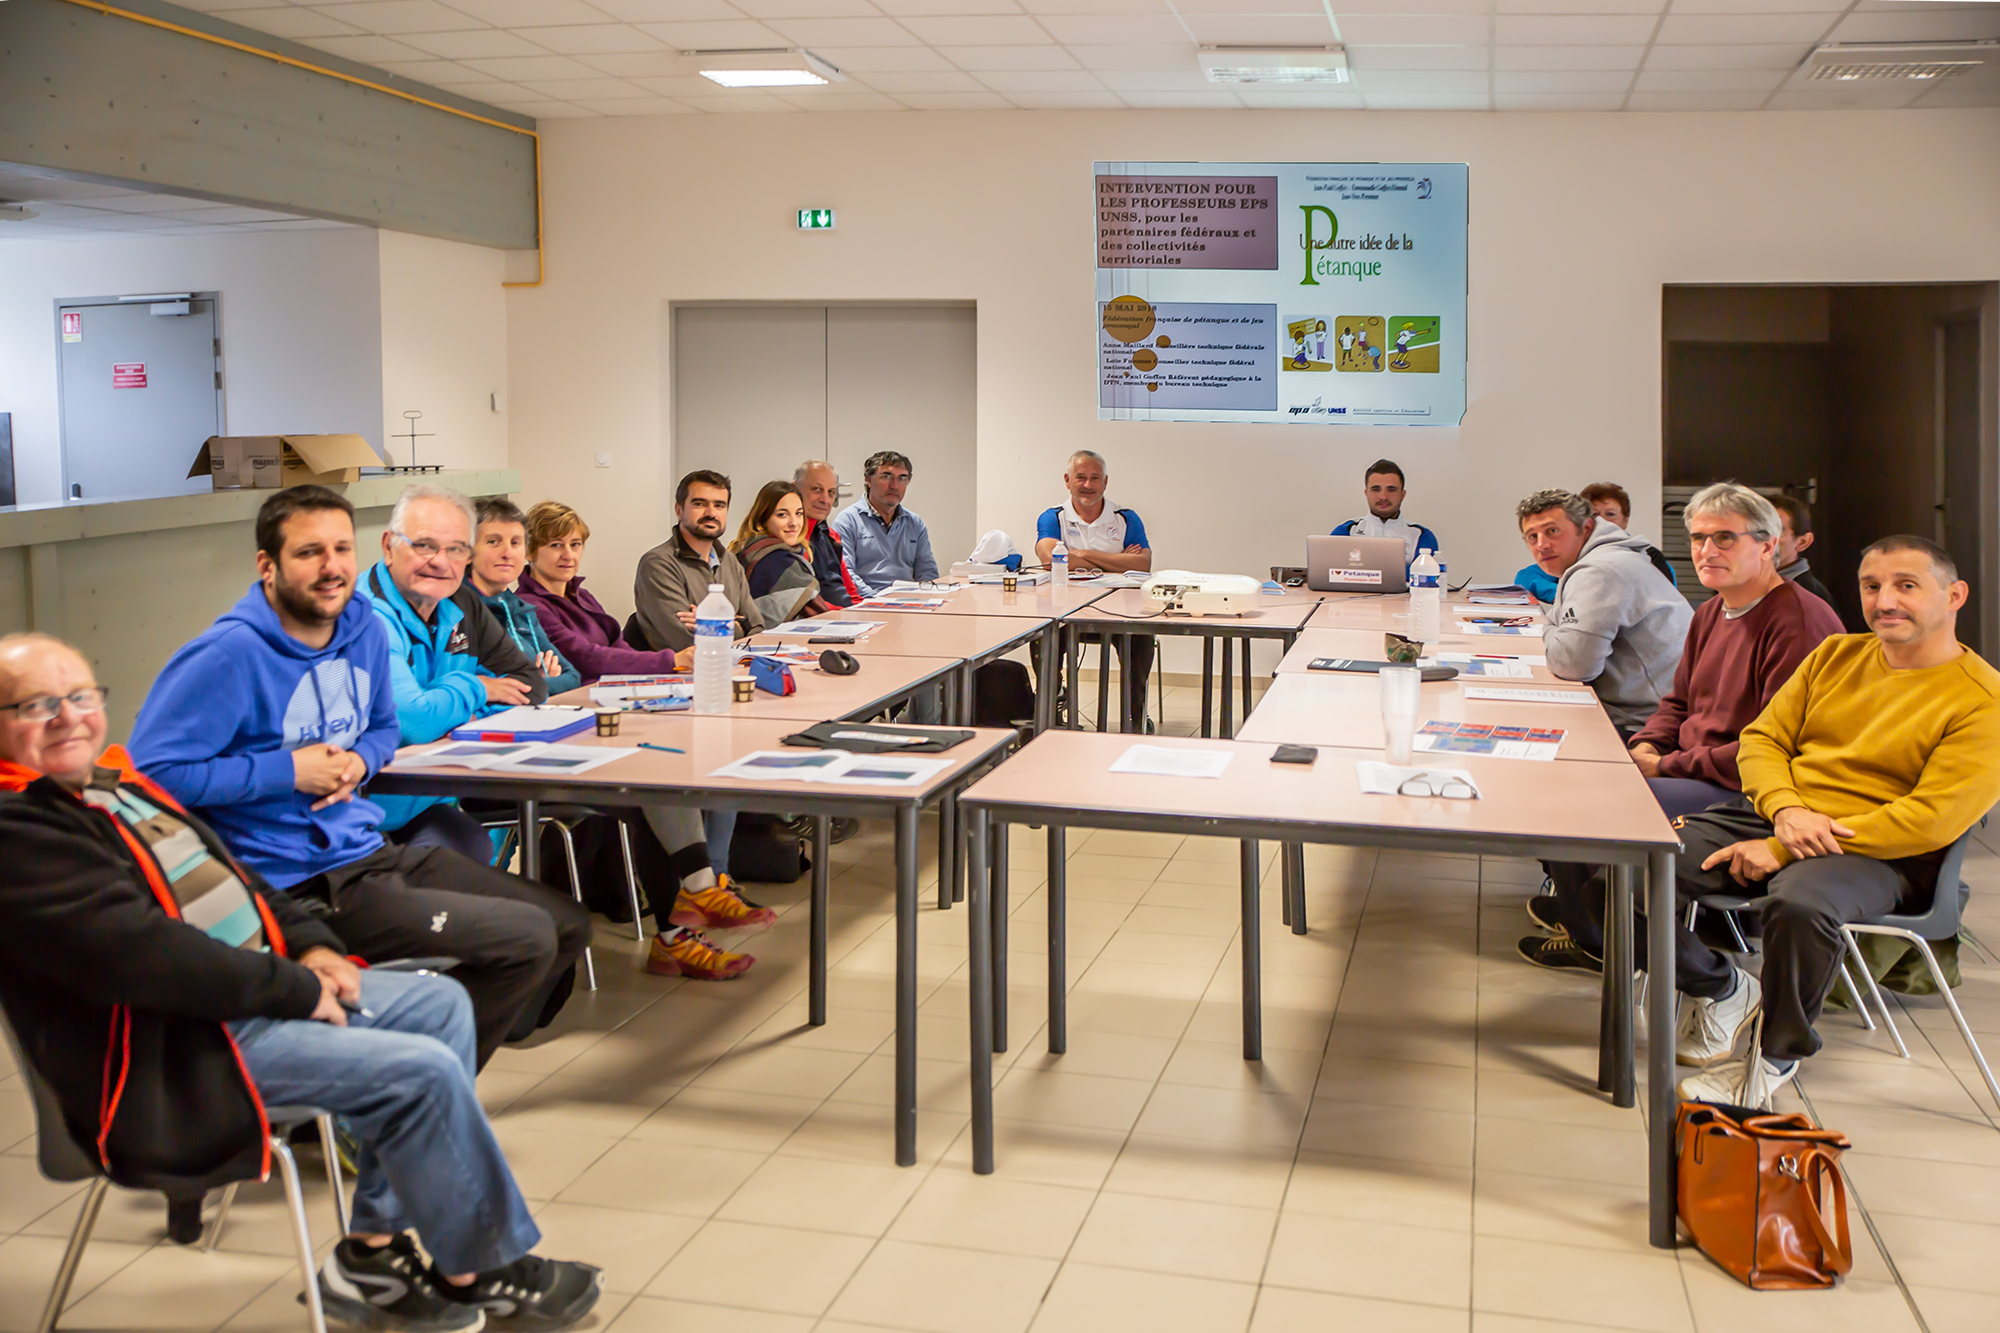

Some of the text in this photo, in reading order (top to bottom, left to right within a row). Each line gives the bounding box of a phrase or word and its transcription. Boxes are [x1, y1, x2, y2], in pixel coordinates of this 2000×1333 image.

[1100, 183, 1256, 194] INTERVENTION POUR
[1100, 198, 1268, 209] LES PROFESSEURS EPS
[1101, 212, 1198, 224] UNSS, pour les
[1101, 227, 1256, 238] partenaires fédéraux et
[1101, 241, 1206, 251] des collectivités
[1299, 233, 1413, 250] Une autre idée de la
[1102, 254, 1181, 265] territoriales
